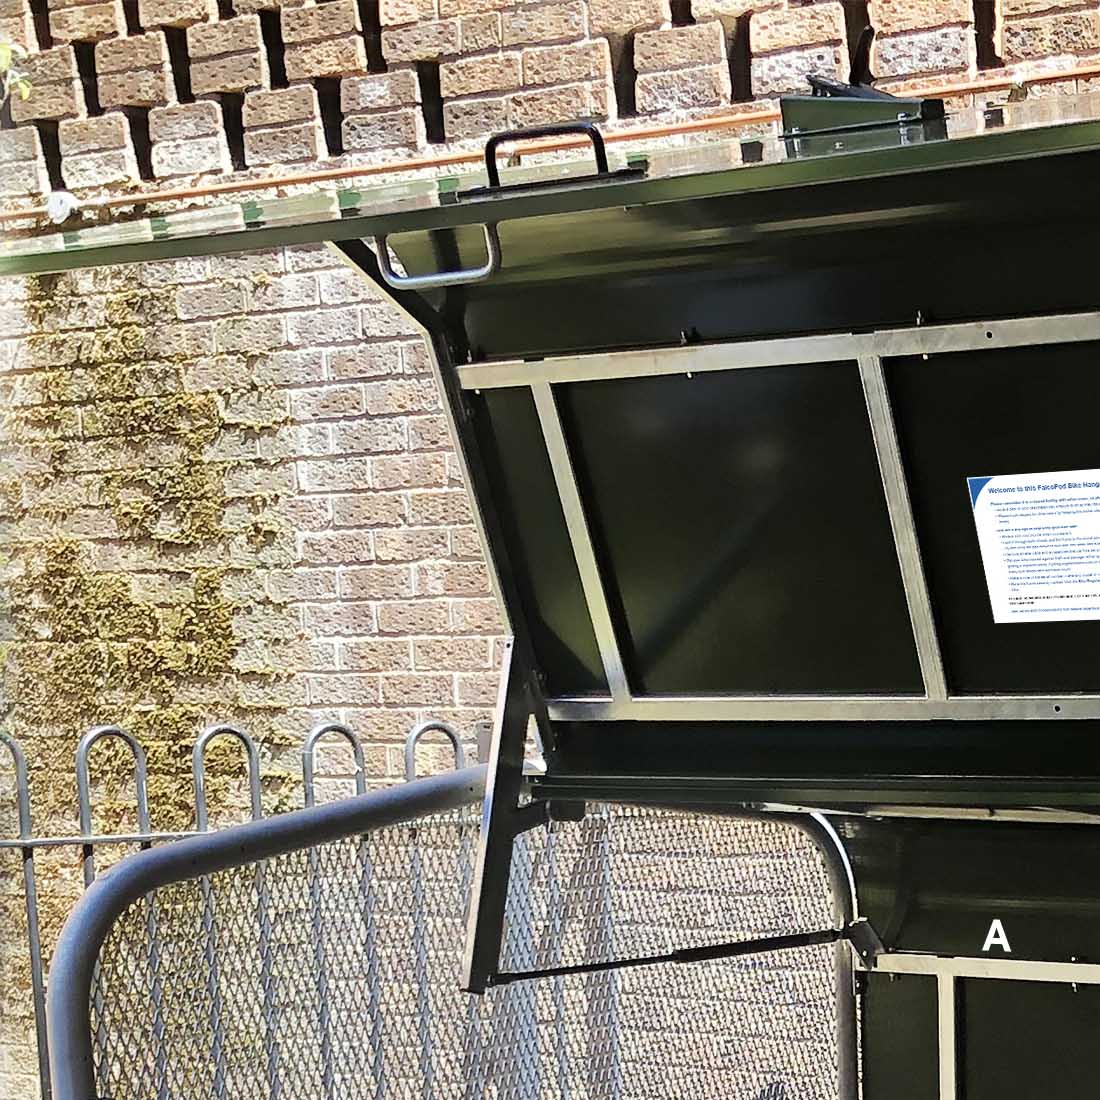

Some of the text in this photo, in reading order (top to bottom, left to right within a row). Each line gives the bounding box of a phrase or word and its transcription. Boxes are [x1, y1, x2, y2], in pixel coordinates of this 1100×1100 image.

[988, 486, 1015, 494] Welcome
[1024, 484, 1036, 492] this
[1037, 482, 1067, 491] FalcoPod
[982, 918, 1012, 952] A
